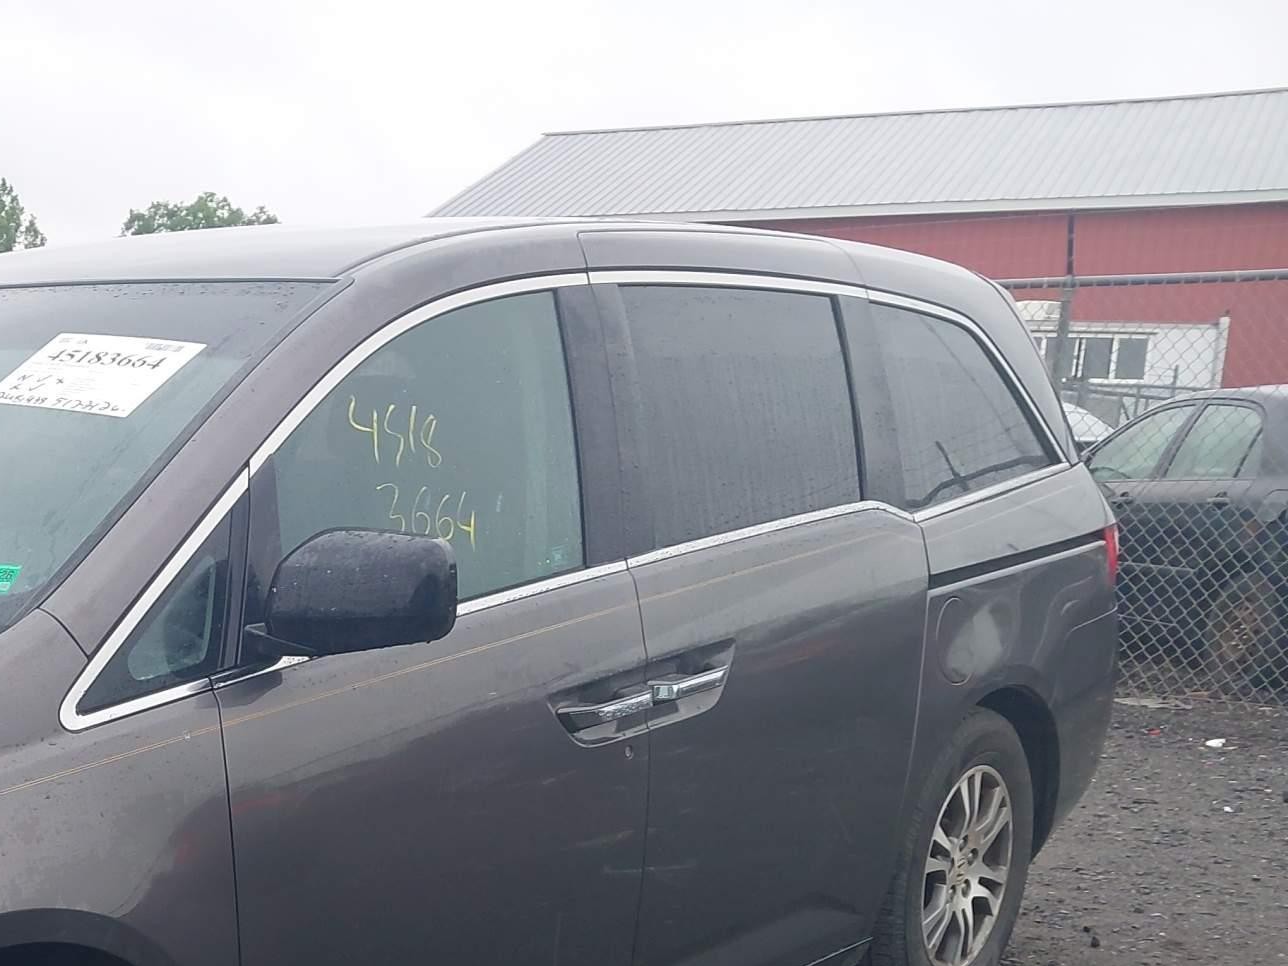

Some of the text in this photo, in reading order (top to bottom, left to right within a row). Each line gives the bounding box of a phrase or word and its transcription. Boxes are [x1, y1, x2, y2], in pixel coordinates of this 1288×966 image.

[47, 348, 168, 370] 45183664
[348, 395, 442, 468] 4518
[376, 483, 476, 551] 3664
